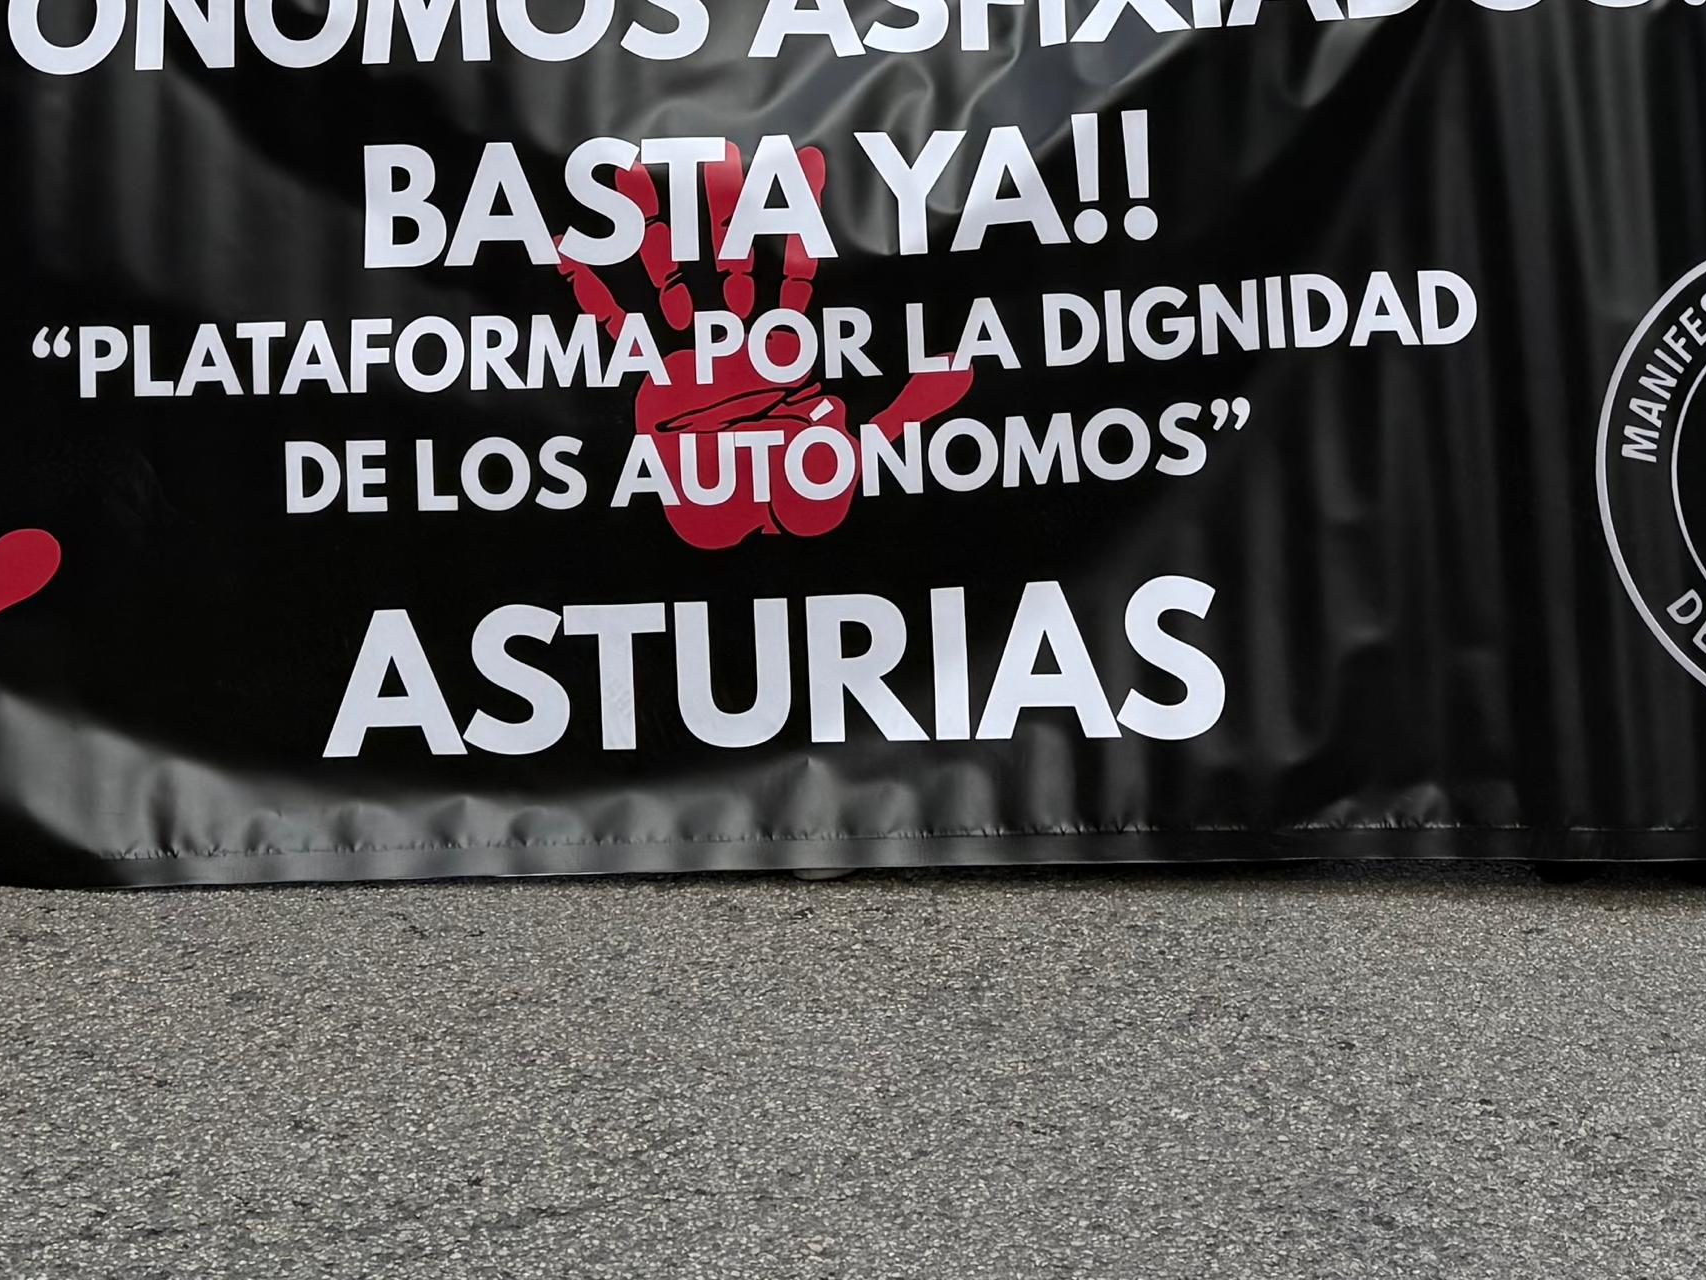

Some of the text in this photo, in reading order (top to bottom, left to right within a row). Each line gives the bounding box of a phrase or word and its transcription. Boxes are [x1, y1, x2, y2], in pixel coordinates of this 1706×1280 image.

[363, 108, 1160, 270] BASTA YA!!
[31, 269, 1478, 398] “PLATAFORMA POR LA DIGNIDAD
[285, 397, 1251, 514] DE LOS AUTÓNOMOS”
[322, 574, 1227, 759] ASTURIAS
